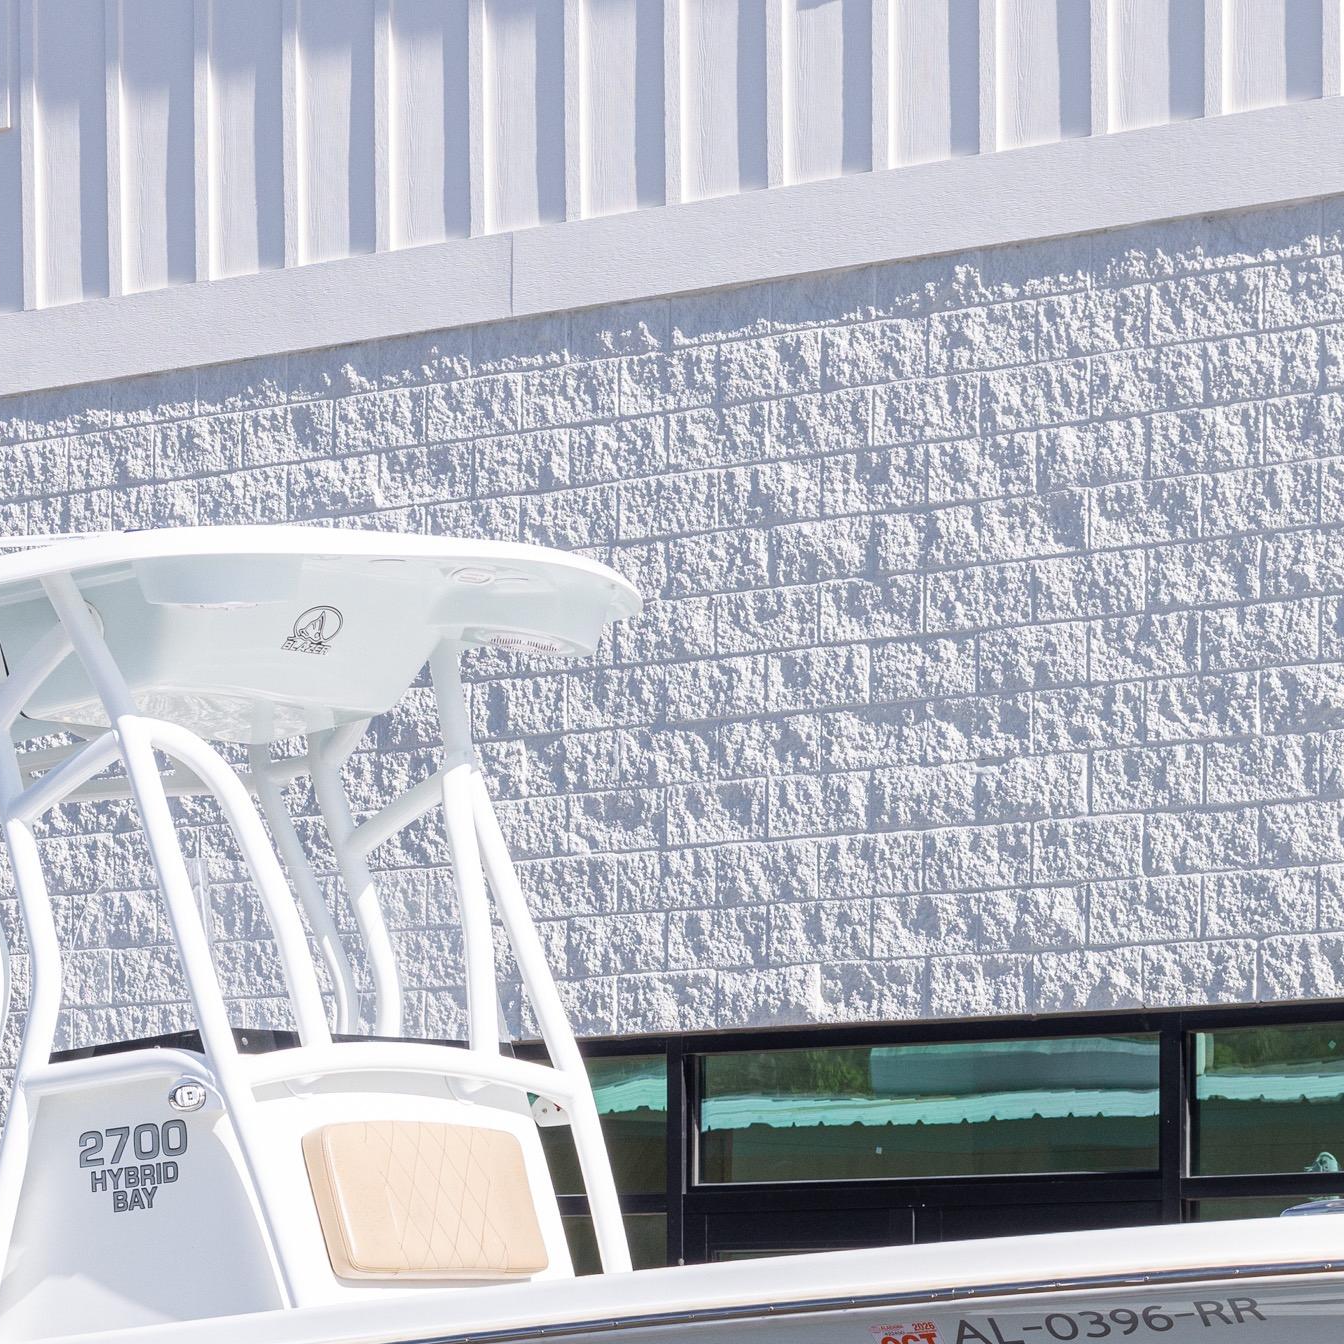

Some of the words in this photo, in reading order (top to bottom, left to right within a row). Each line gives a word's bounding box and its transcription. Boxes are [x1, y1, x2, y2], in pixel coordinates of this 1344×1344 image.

[281, 637, 332, 656] BLAZER
[79, 1119, 188, 1168] 2700
[90, 1161, 179, 1192] HYBRID
[112, 1186, 158, 1213] BAY
[911, 1321, 936, 1332] 2026
